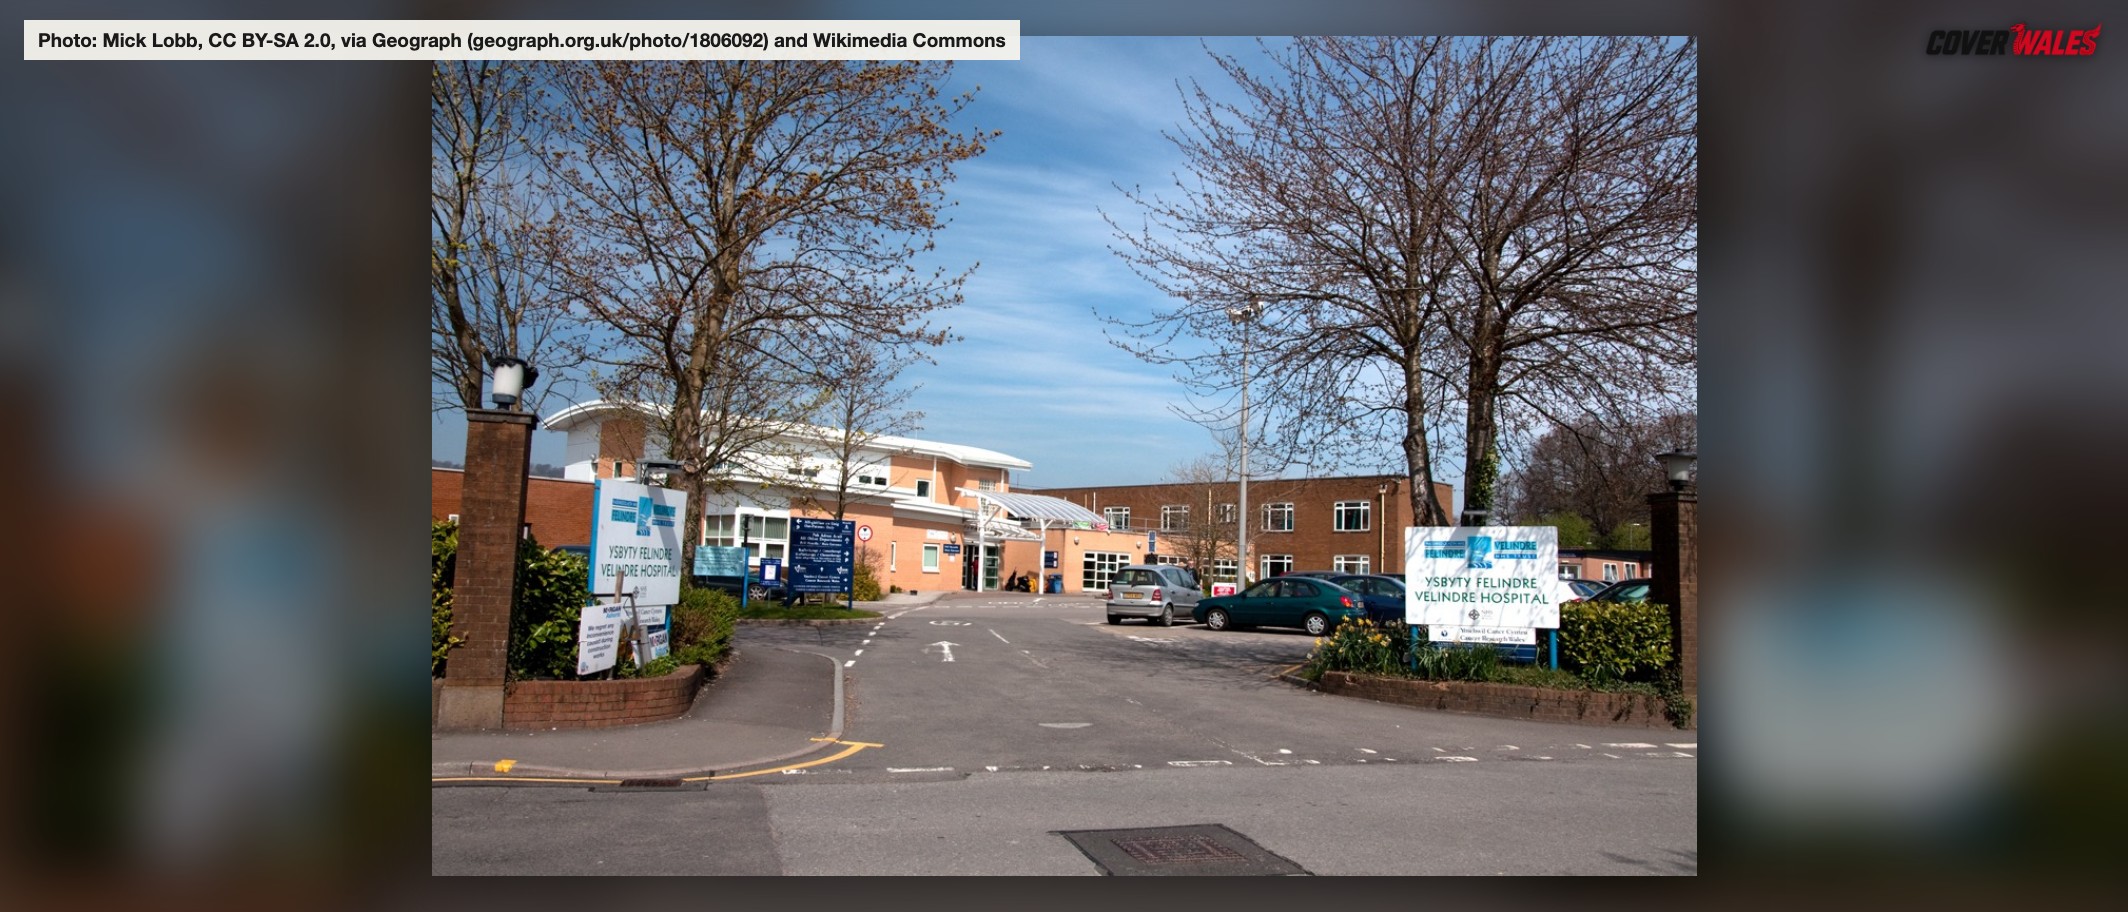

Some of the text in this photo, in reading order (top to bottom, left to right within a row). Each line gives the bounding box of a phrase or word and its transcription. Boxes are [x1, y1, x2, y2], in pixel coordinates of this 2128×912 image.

[1494, 541, 1537, 550] VELINDRE
[608, 545, 673, 561] YSBYTY FELINDRE
[1425, 549, 1464, 559] FELINDRE
[601, 563, 677, 578] VELINDRE HOSPITAL
[1425, 577, 1538, 589] YSBYTY FELINDRE
[1415, 591, 1550, 605] VELINDRE HOSPITAL
